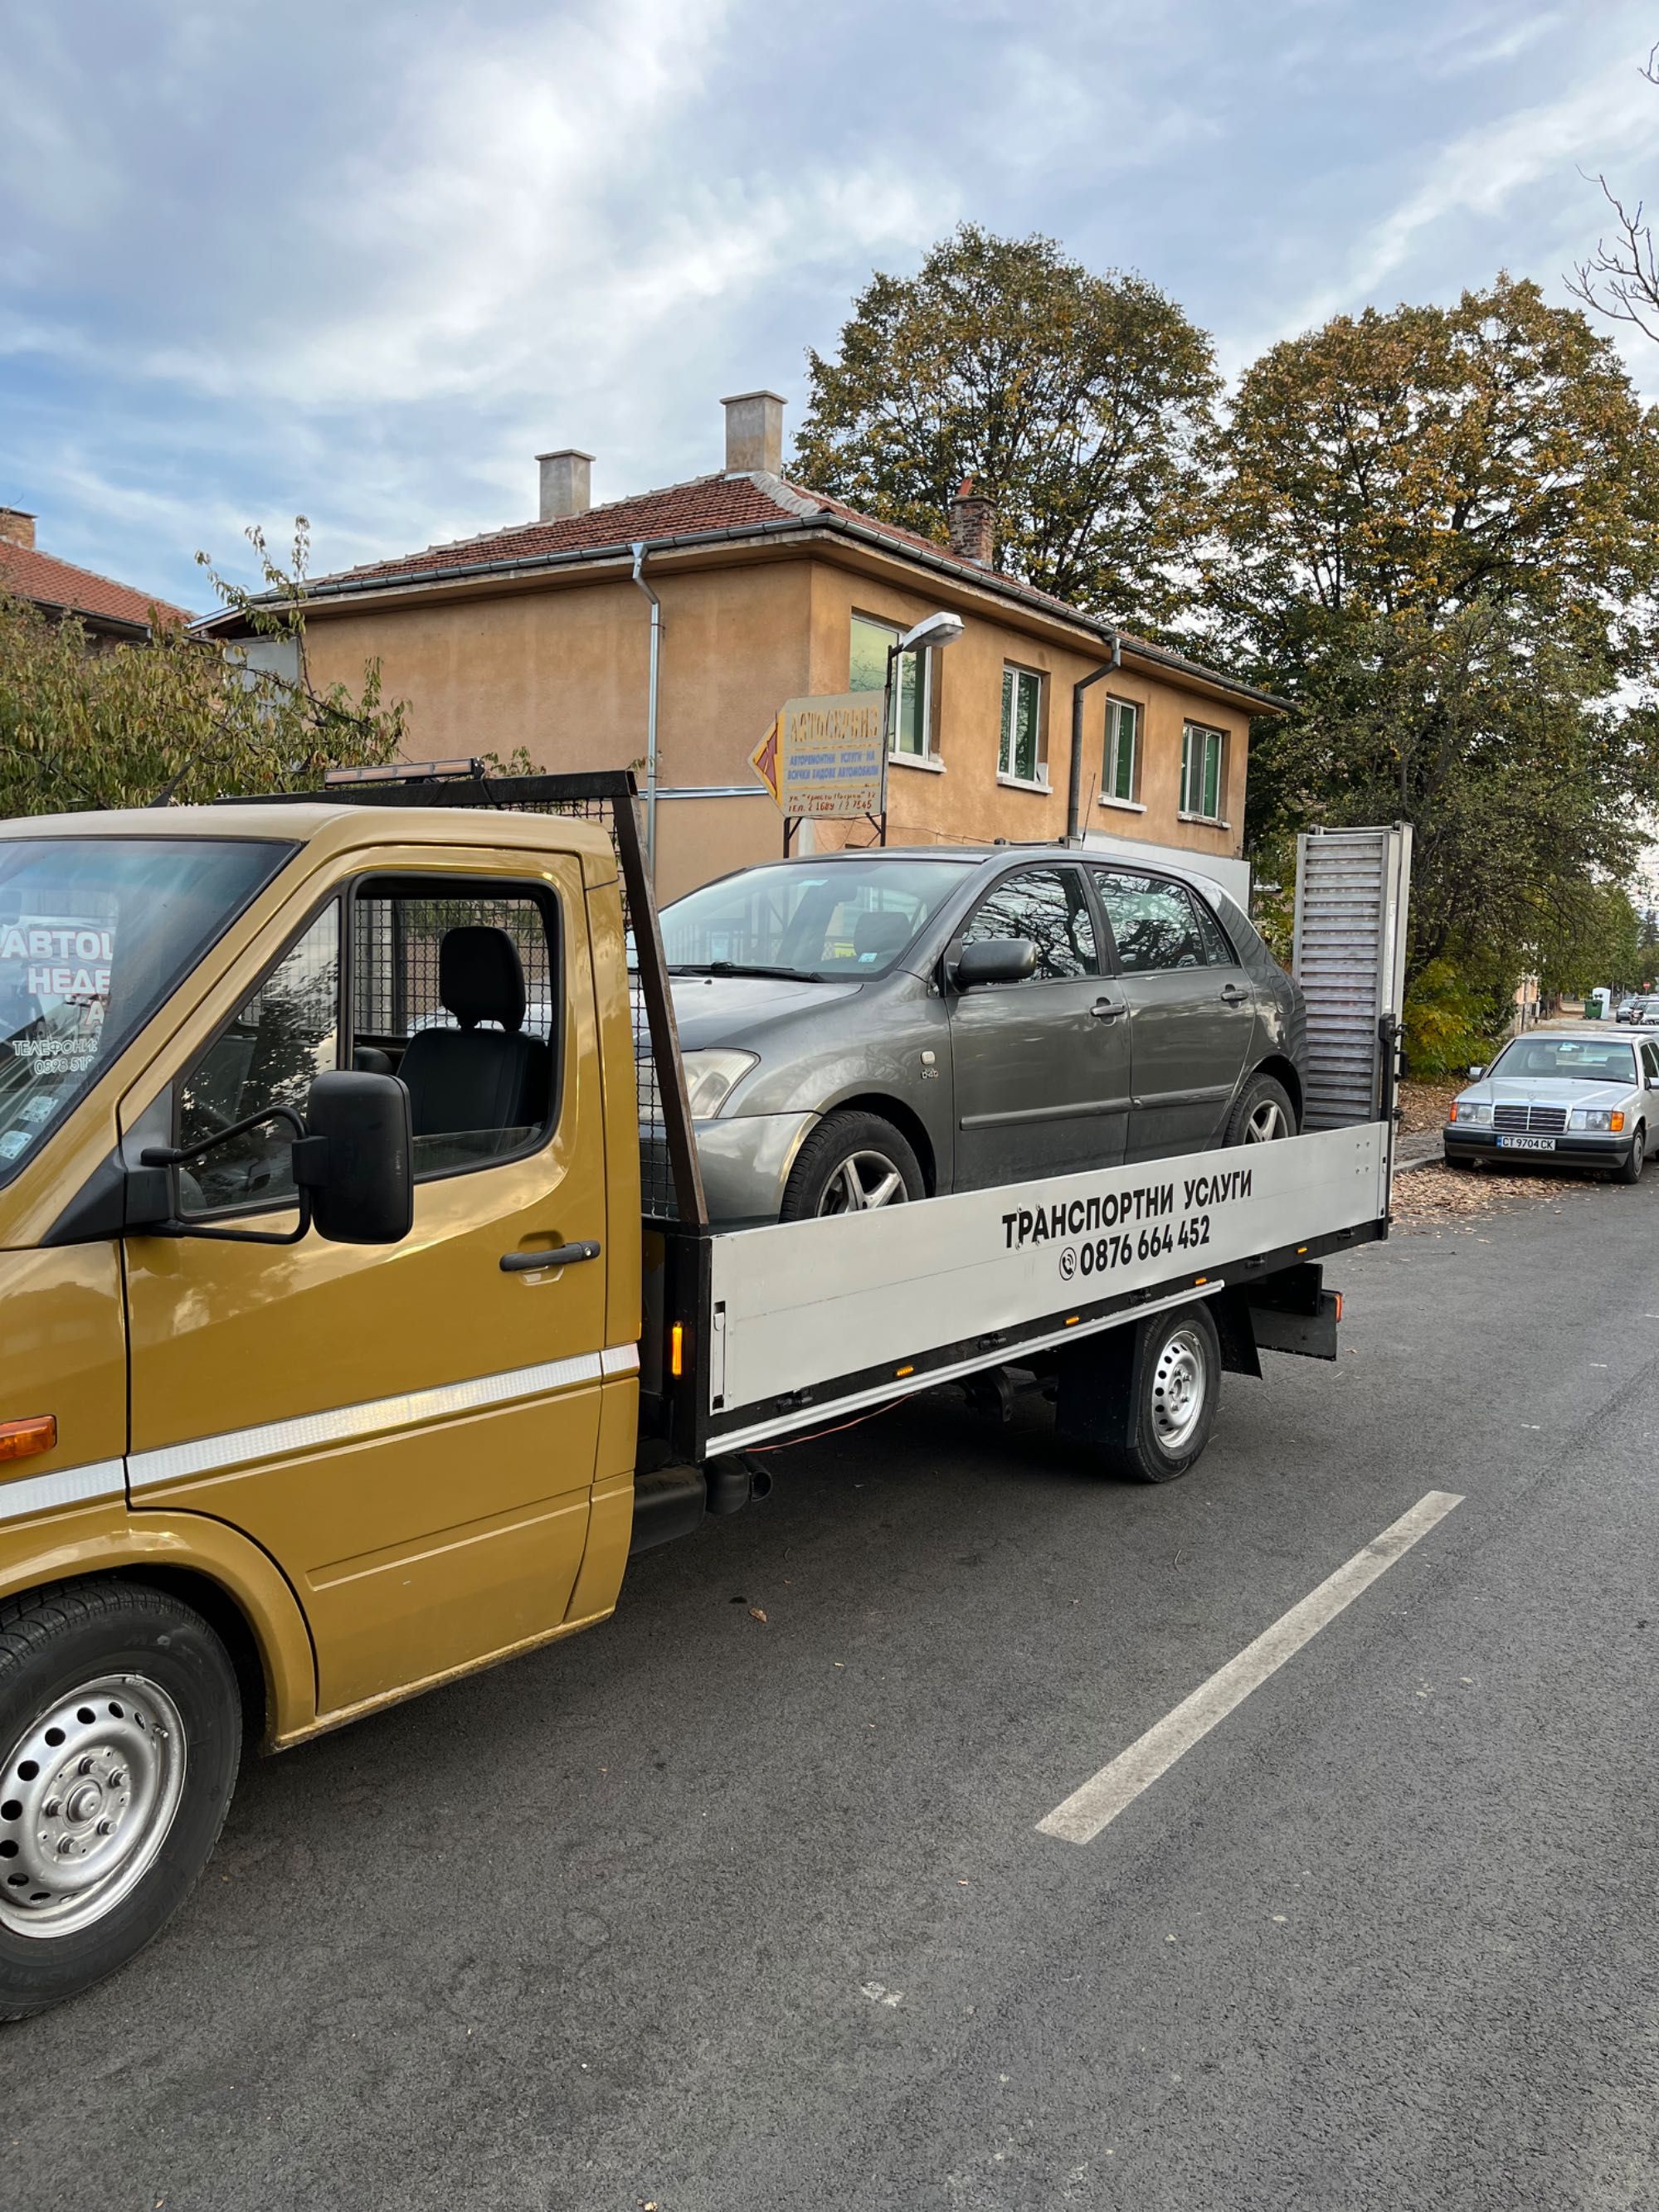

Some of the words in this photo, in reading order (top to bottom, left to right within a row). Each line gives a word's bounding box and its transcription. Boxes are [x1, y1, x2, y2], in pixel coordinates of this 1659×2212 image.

[866, 750, 876, 761] НА
[1516, 1139, 1539, 1148] 9704
[1002, 1183, 1174, 1248] ТРАНСПОРТНИ
[1184, 1169, 1252, 1209] УСЛУГИ
[1080, 1234, 1132, 1276] 0876
[1137, 1223, 1173, 1261] 664
[1178, 1214, 1209, 1249] 452
